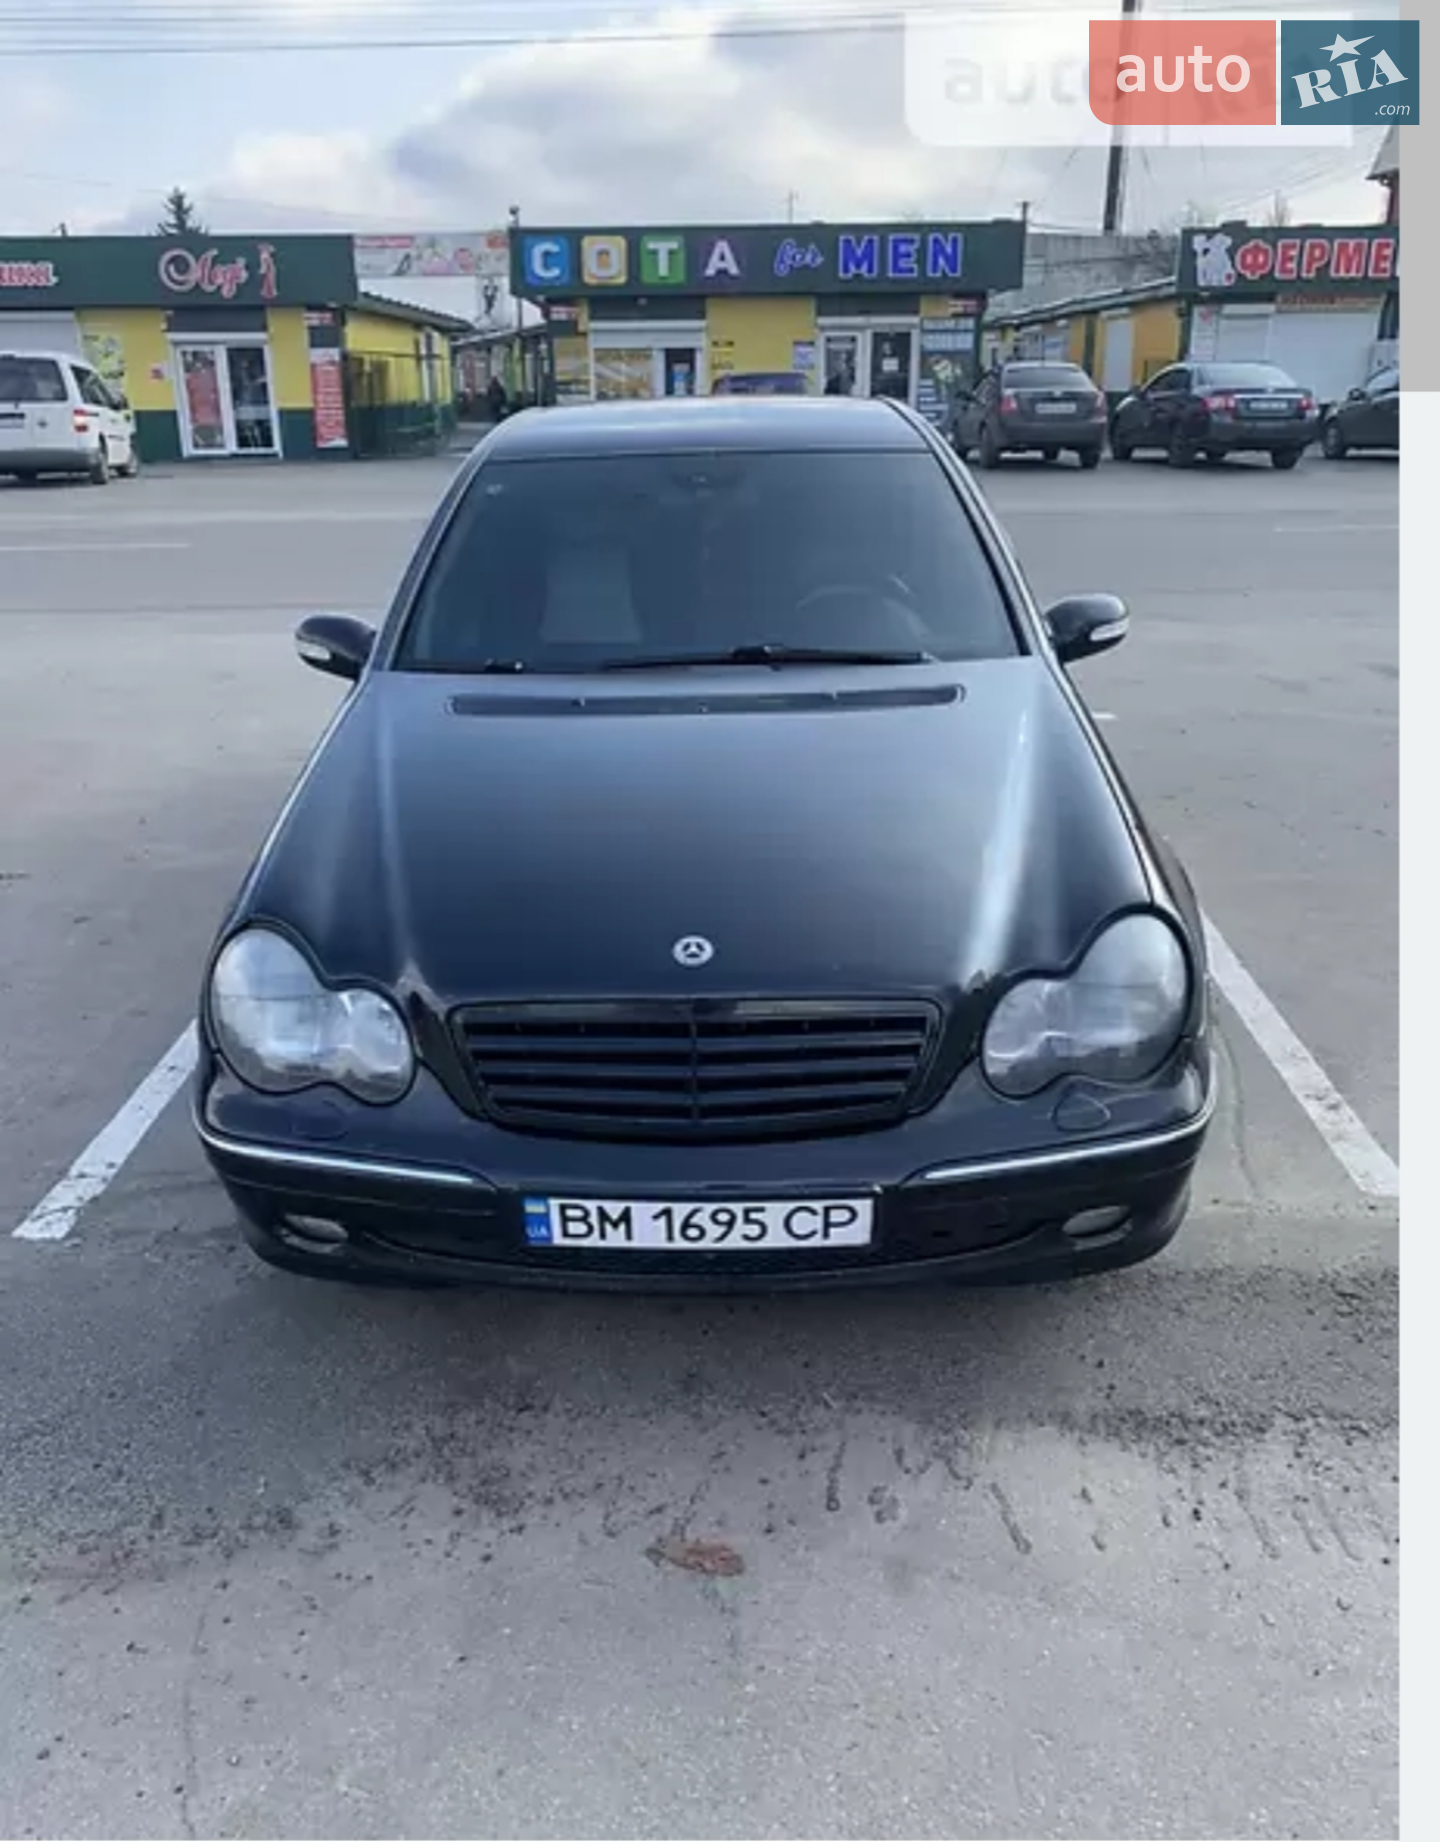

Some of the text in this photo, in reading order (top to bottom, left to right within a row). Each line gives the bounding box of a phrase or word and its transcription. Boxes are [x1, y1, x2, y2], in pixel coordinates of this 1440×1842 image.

[774, 238, 825, 278] for
[838, 232, 963, 280] MEN
[1235, 238, 1400, 280] ФЕРМЕ
[526, 1225, 549, 1238] UA
[558, 1203, 860, 1243] BM 1695 CP
